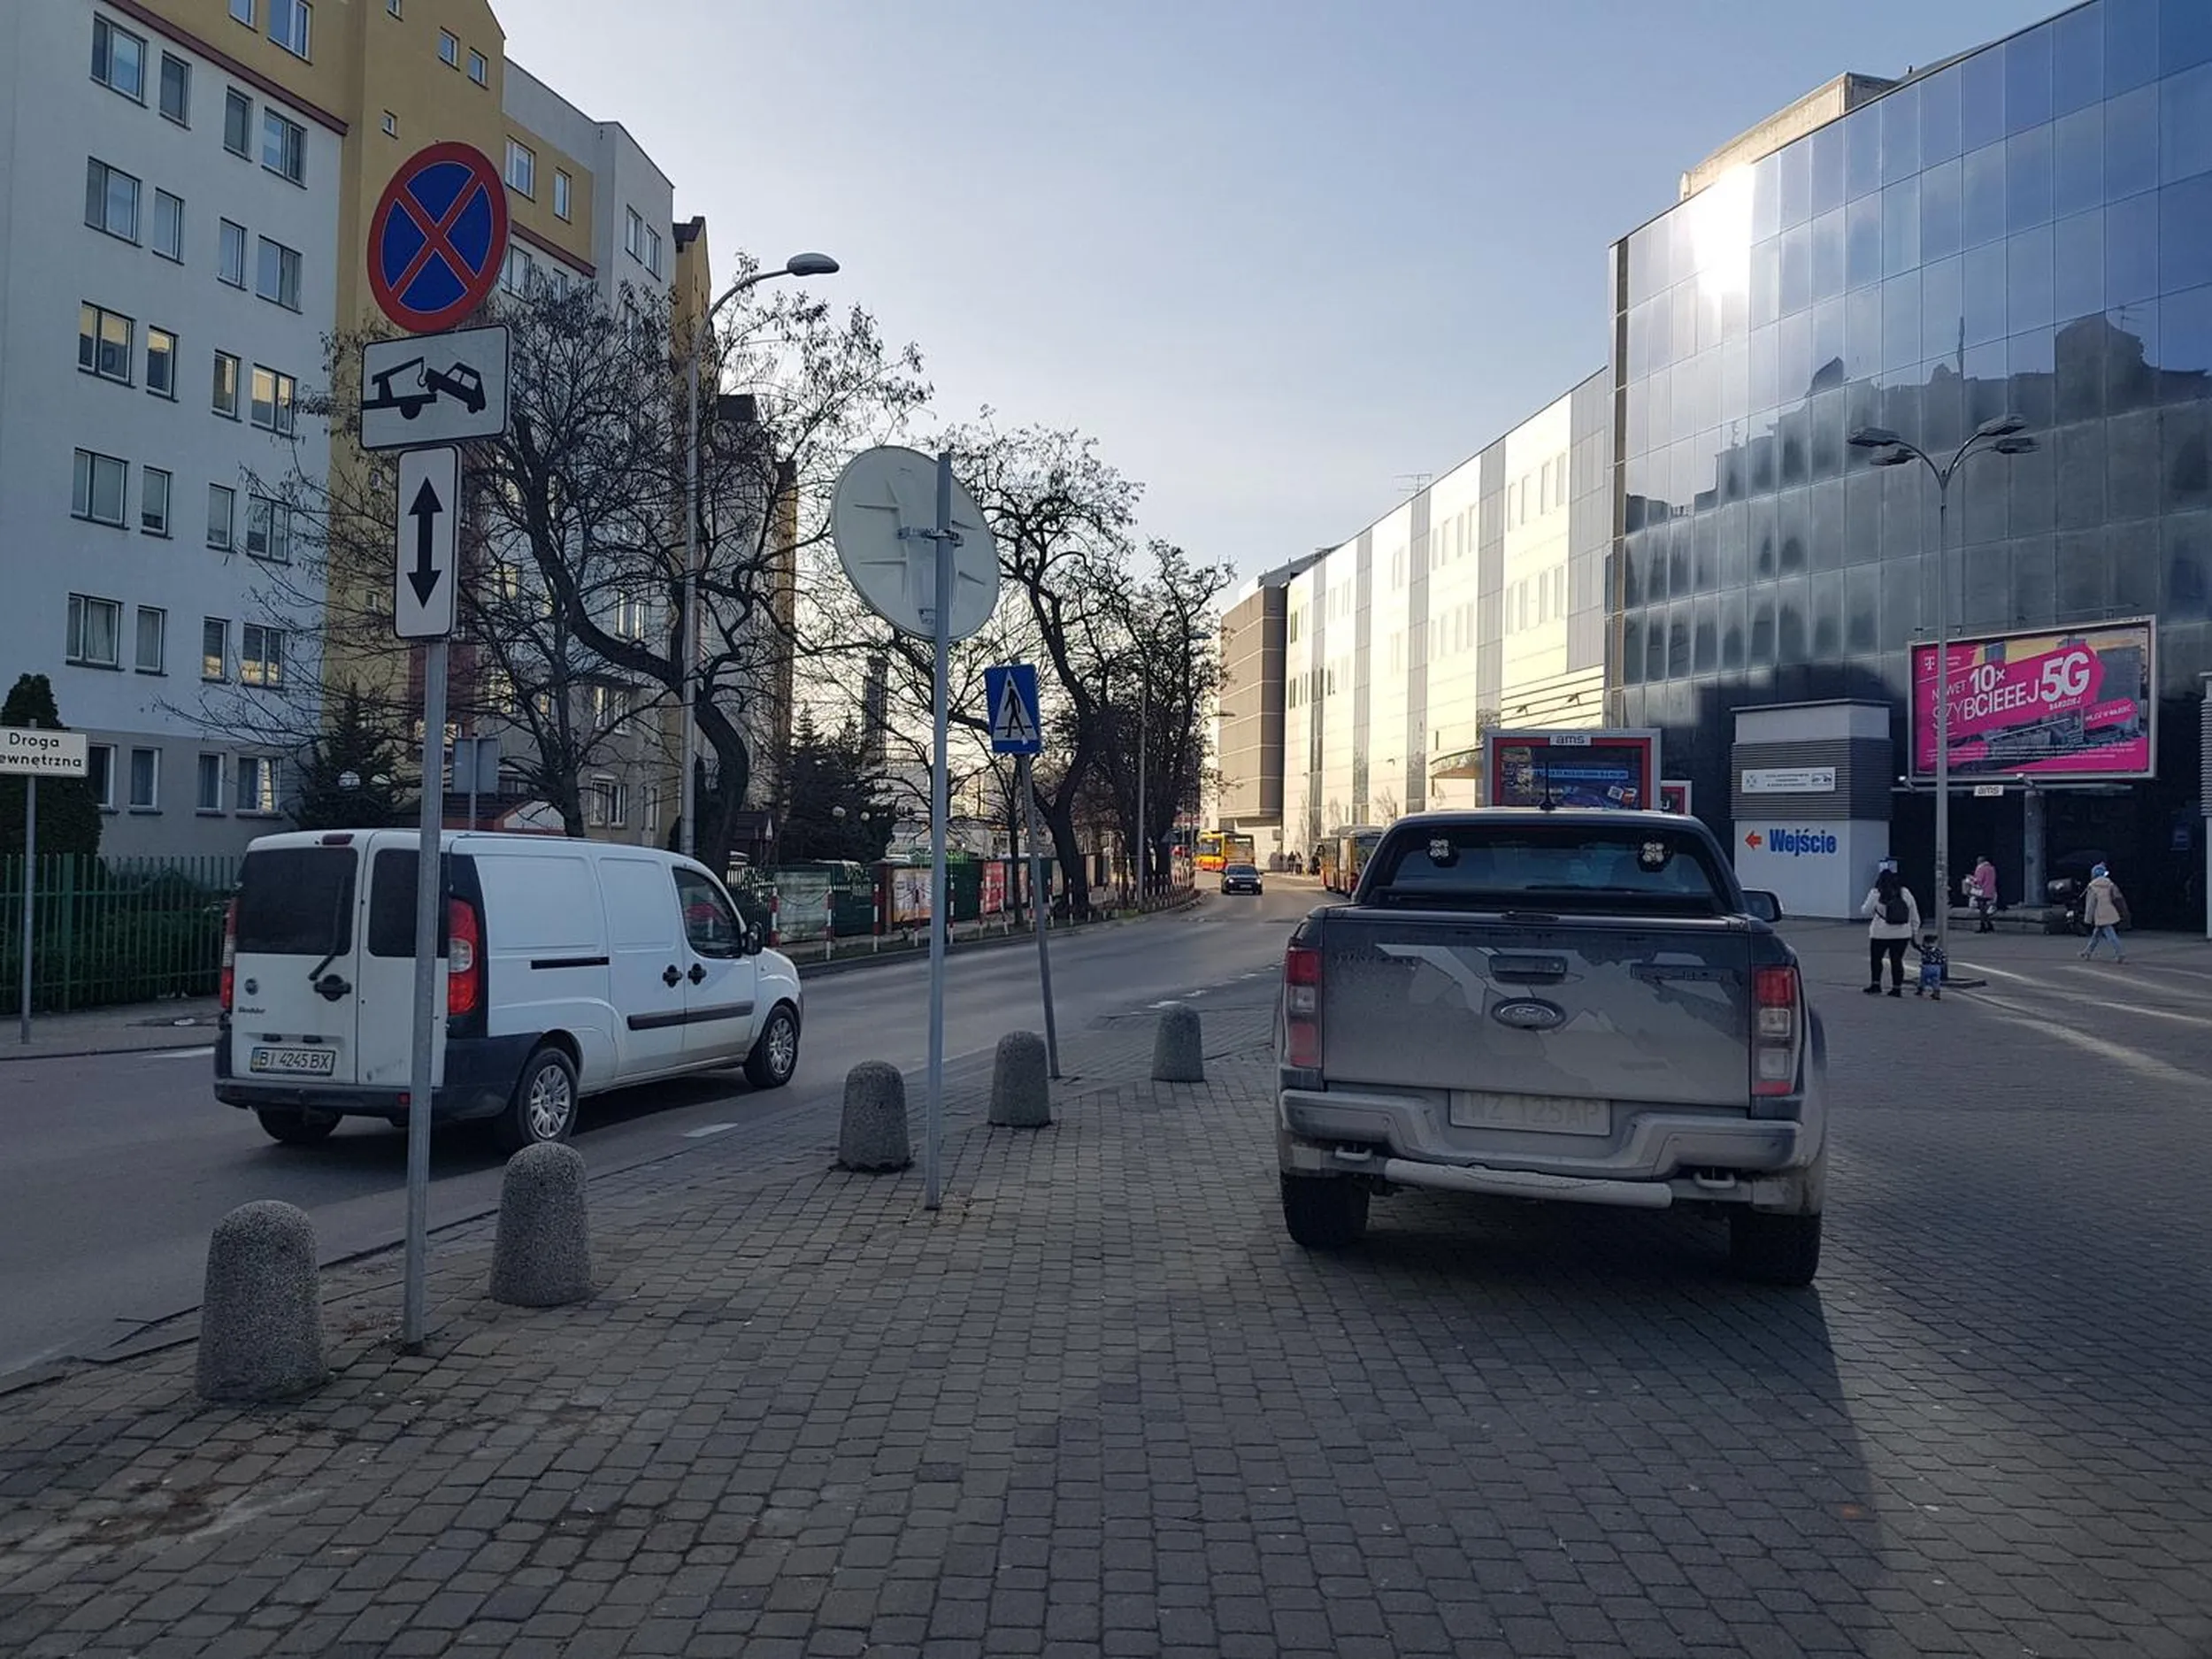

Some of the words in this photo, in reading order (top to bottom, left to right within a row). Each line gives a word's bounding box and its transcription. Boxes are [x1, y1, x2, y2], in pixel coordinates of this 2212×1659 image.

[2040, 651, 2090, 703] 5G
[1932, 680, 1966, 701] NWET
[9, 732, 59, 750] Droga
[1555, 735, 1586, 744] ams
[1769, 828, 1837, 856] Wejście
[259, 1051, 276, 1066] BI
